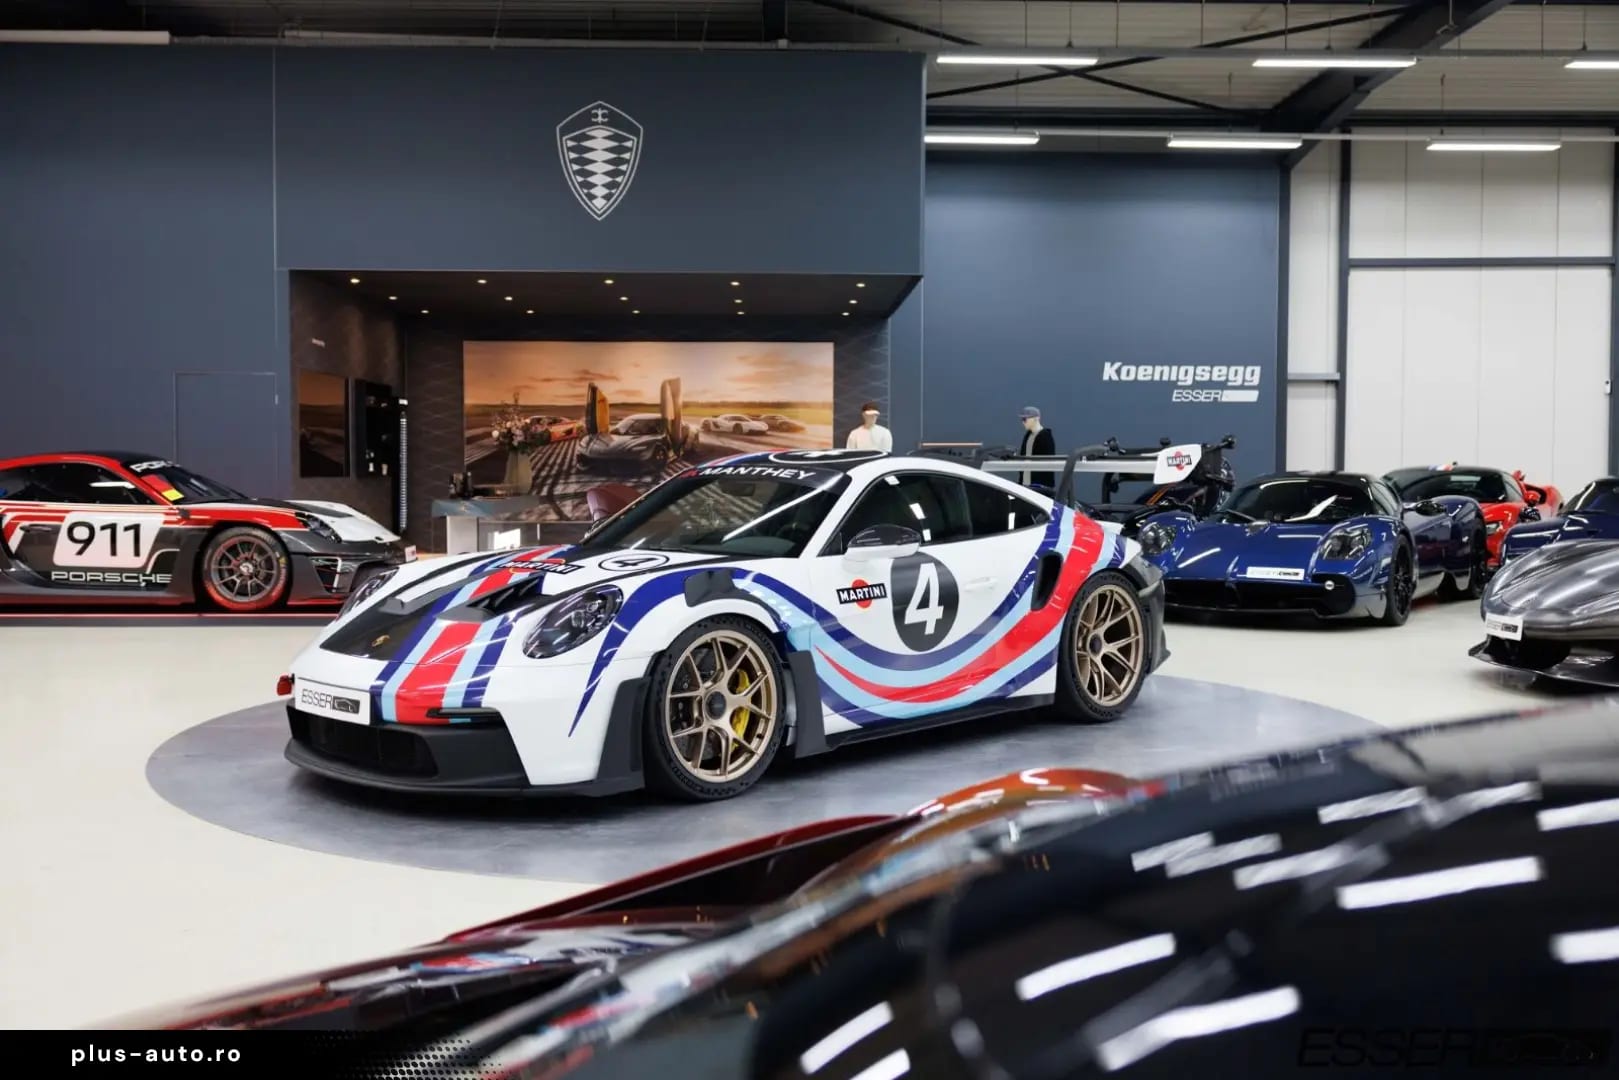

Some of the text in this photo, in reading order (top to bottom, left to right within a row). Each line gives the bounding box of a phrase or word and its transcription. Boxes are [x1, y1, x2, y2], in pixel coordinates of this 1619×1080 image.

[1103, 361, 1262, 386] Koenigsegg
[1172, 389, 1222, 402] ESSER
[699, 466, 816, 480] MANTHEY
[67, 521, 141, 557] 911
[500, 561, 577, 573] MARTINI
[51, 571, 172, 583] PORSCHE
[839, 585, 886, 602] MARTINI
[904, 562, 944, 635] 4
[301, 688, 333, 710] ESSER
